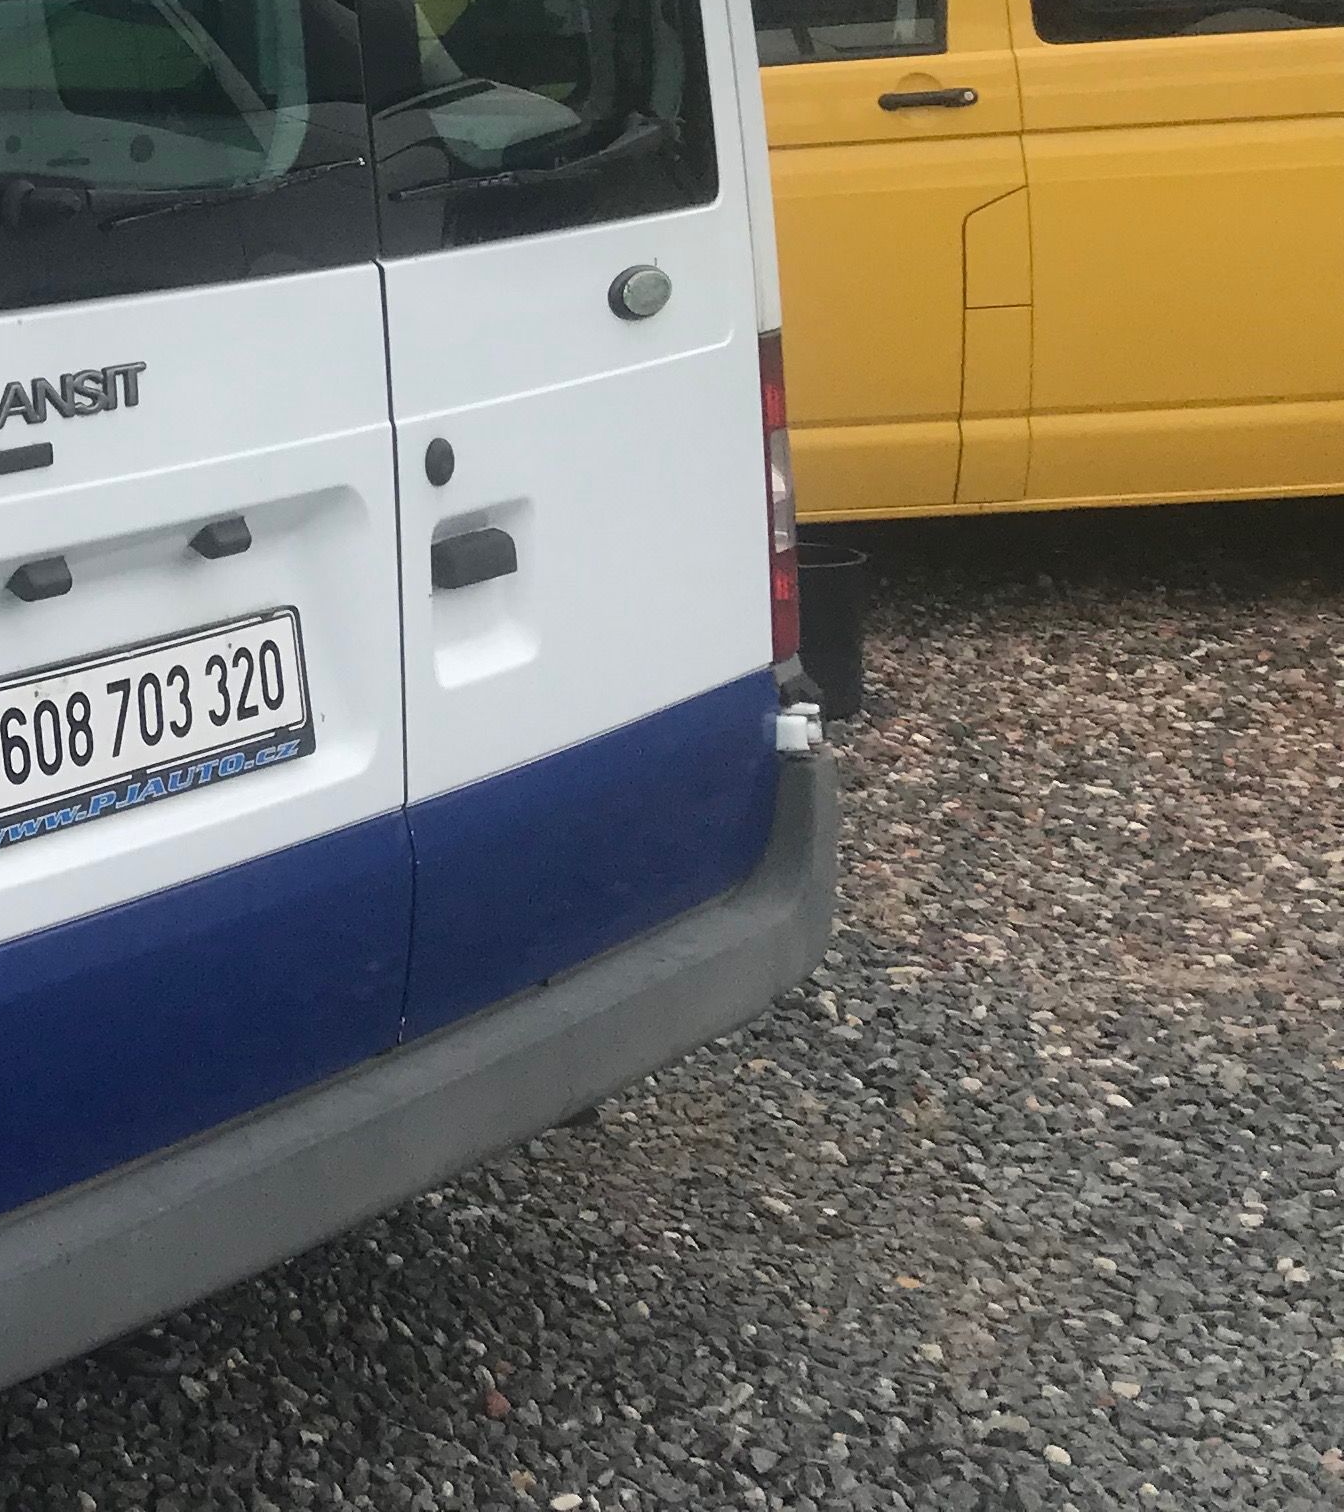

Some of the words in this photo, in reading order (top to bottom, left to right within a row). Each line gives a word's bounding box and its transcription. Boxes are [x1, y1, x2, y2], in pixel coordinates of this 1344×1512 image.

[0, 691, 95, 786] 608
[106, 664, 194, 758] 703
[204, 639, 286, 727] 320
